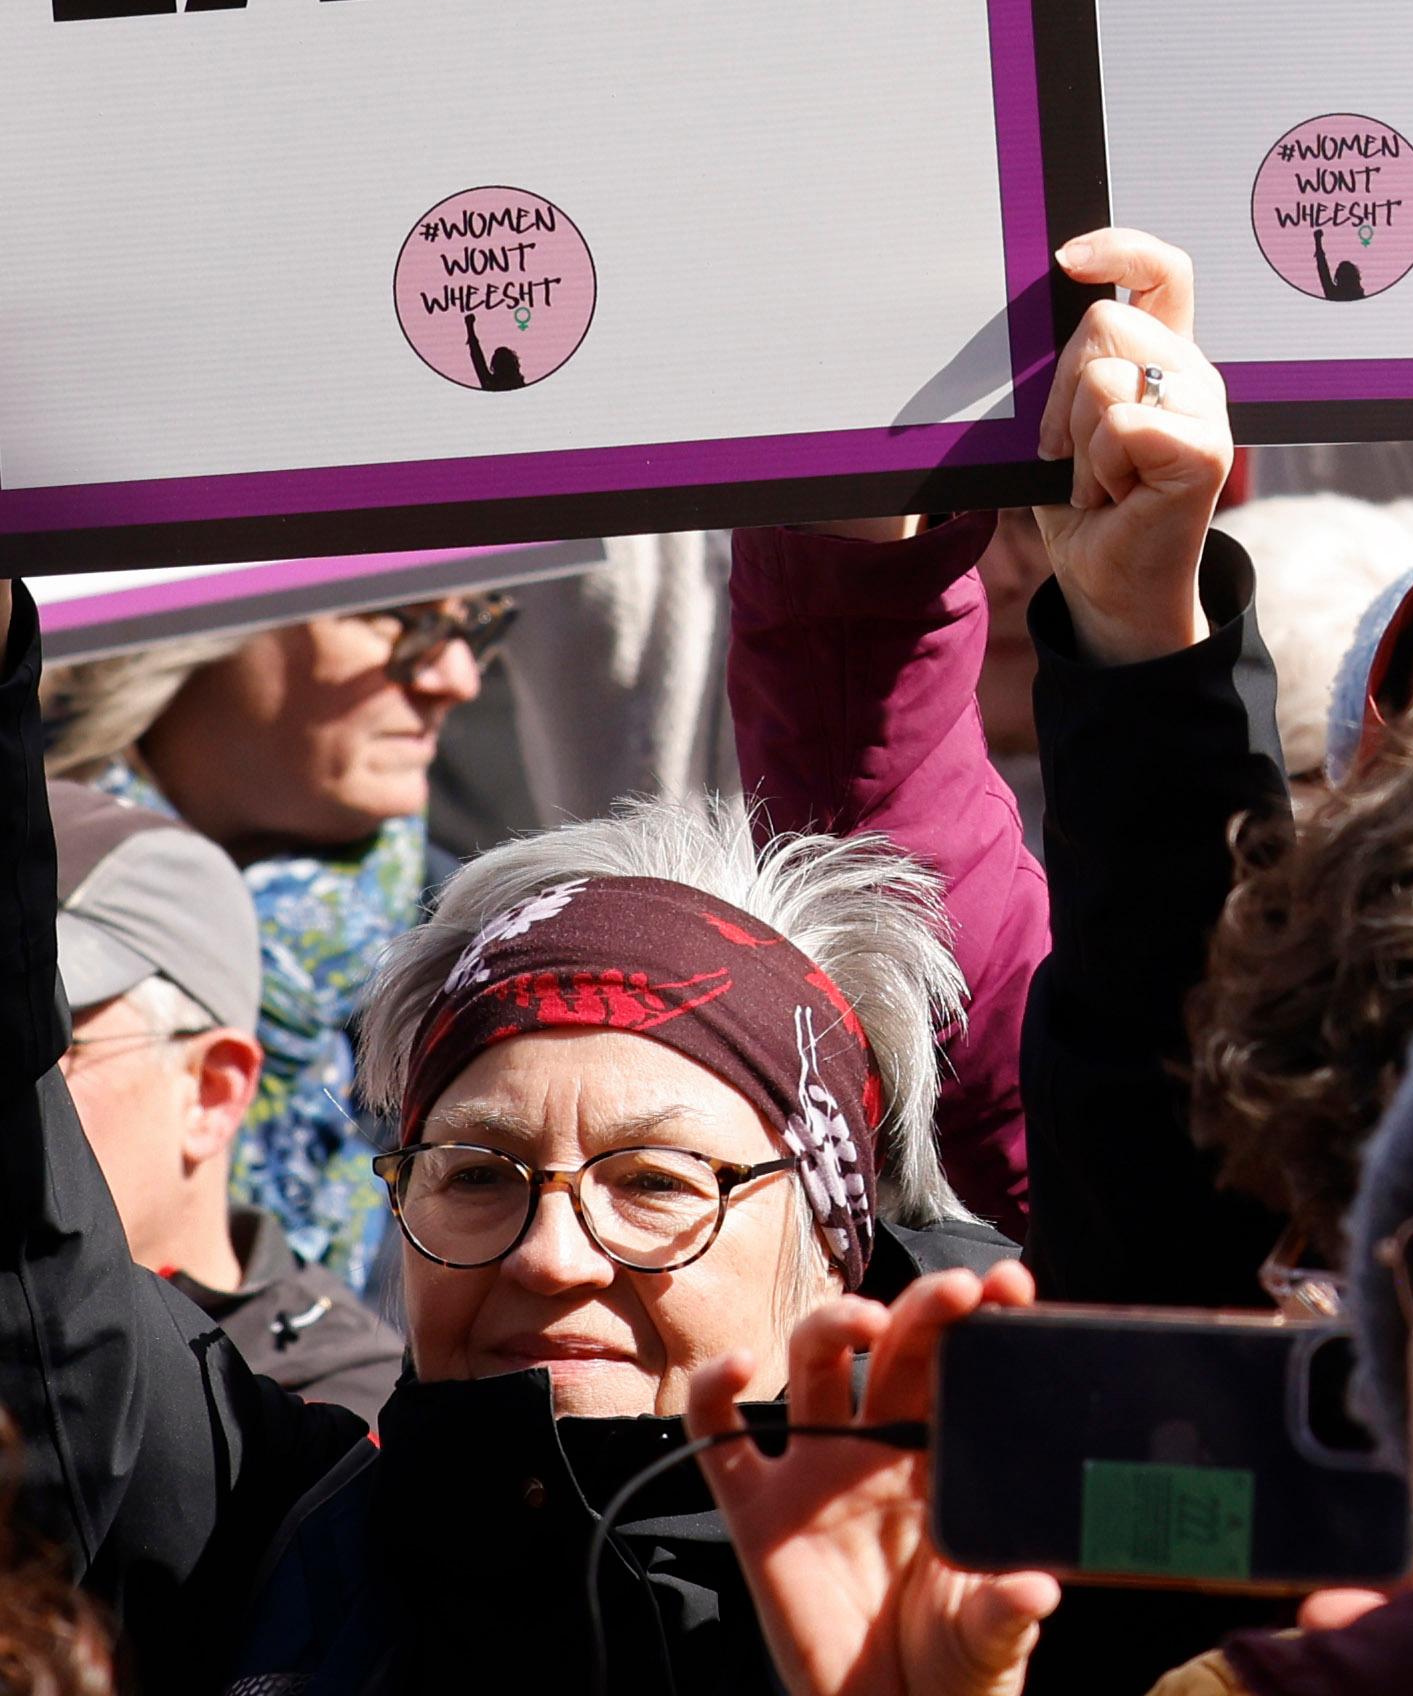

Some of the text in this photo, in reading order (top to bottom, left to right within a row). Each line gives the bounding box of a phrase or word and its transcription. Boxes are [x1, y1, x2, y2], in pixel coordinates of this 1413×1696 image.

[1277, 133, 1400, 162] #WOMEN
[1295, 166, 1381, 194] WONT
[419, 206, 555, 242] #WOMEN
[1275, 199, 1402, 228] WHEESHT
[440, 242, 536, 276] WONT
[420, 278, 561, 314] WHEESHT
